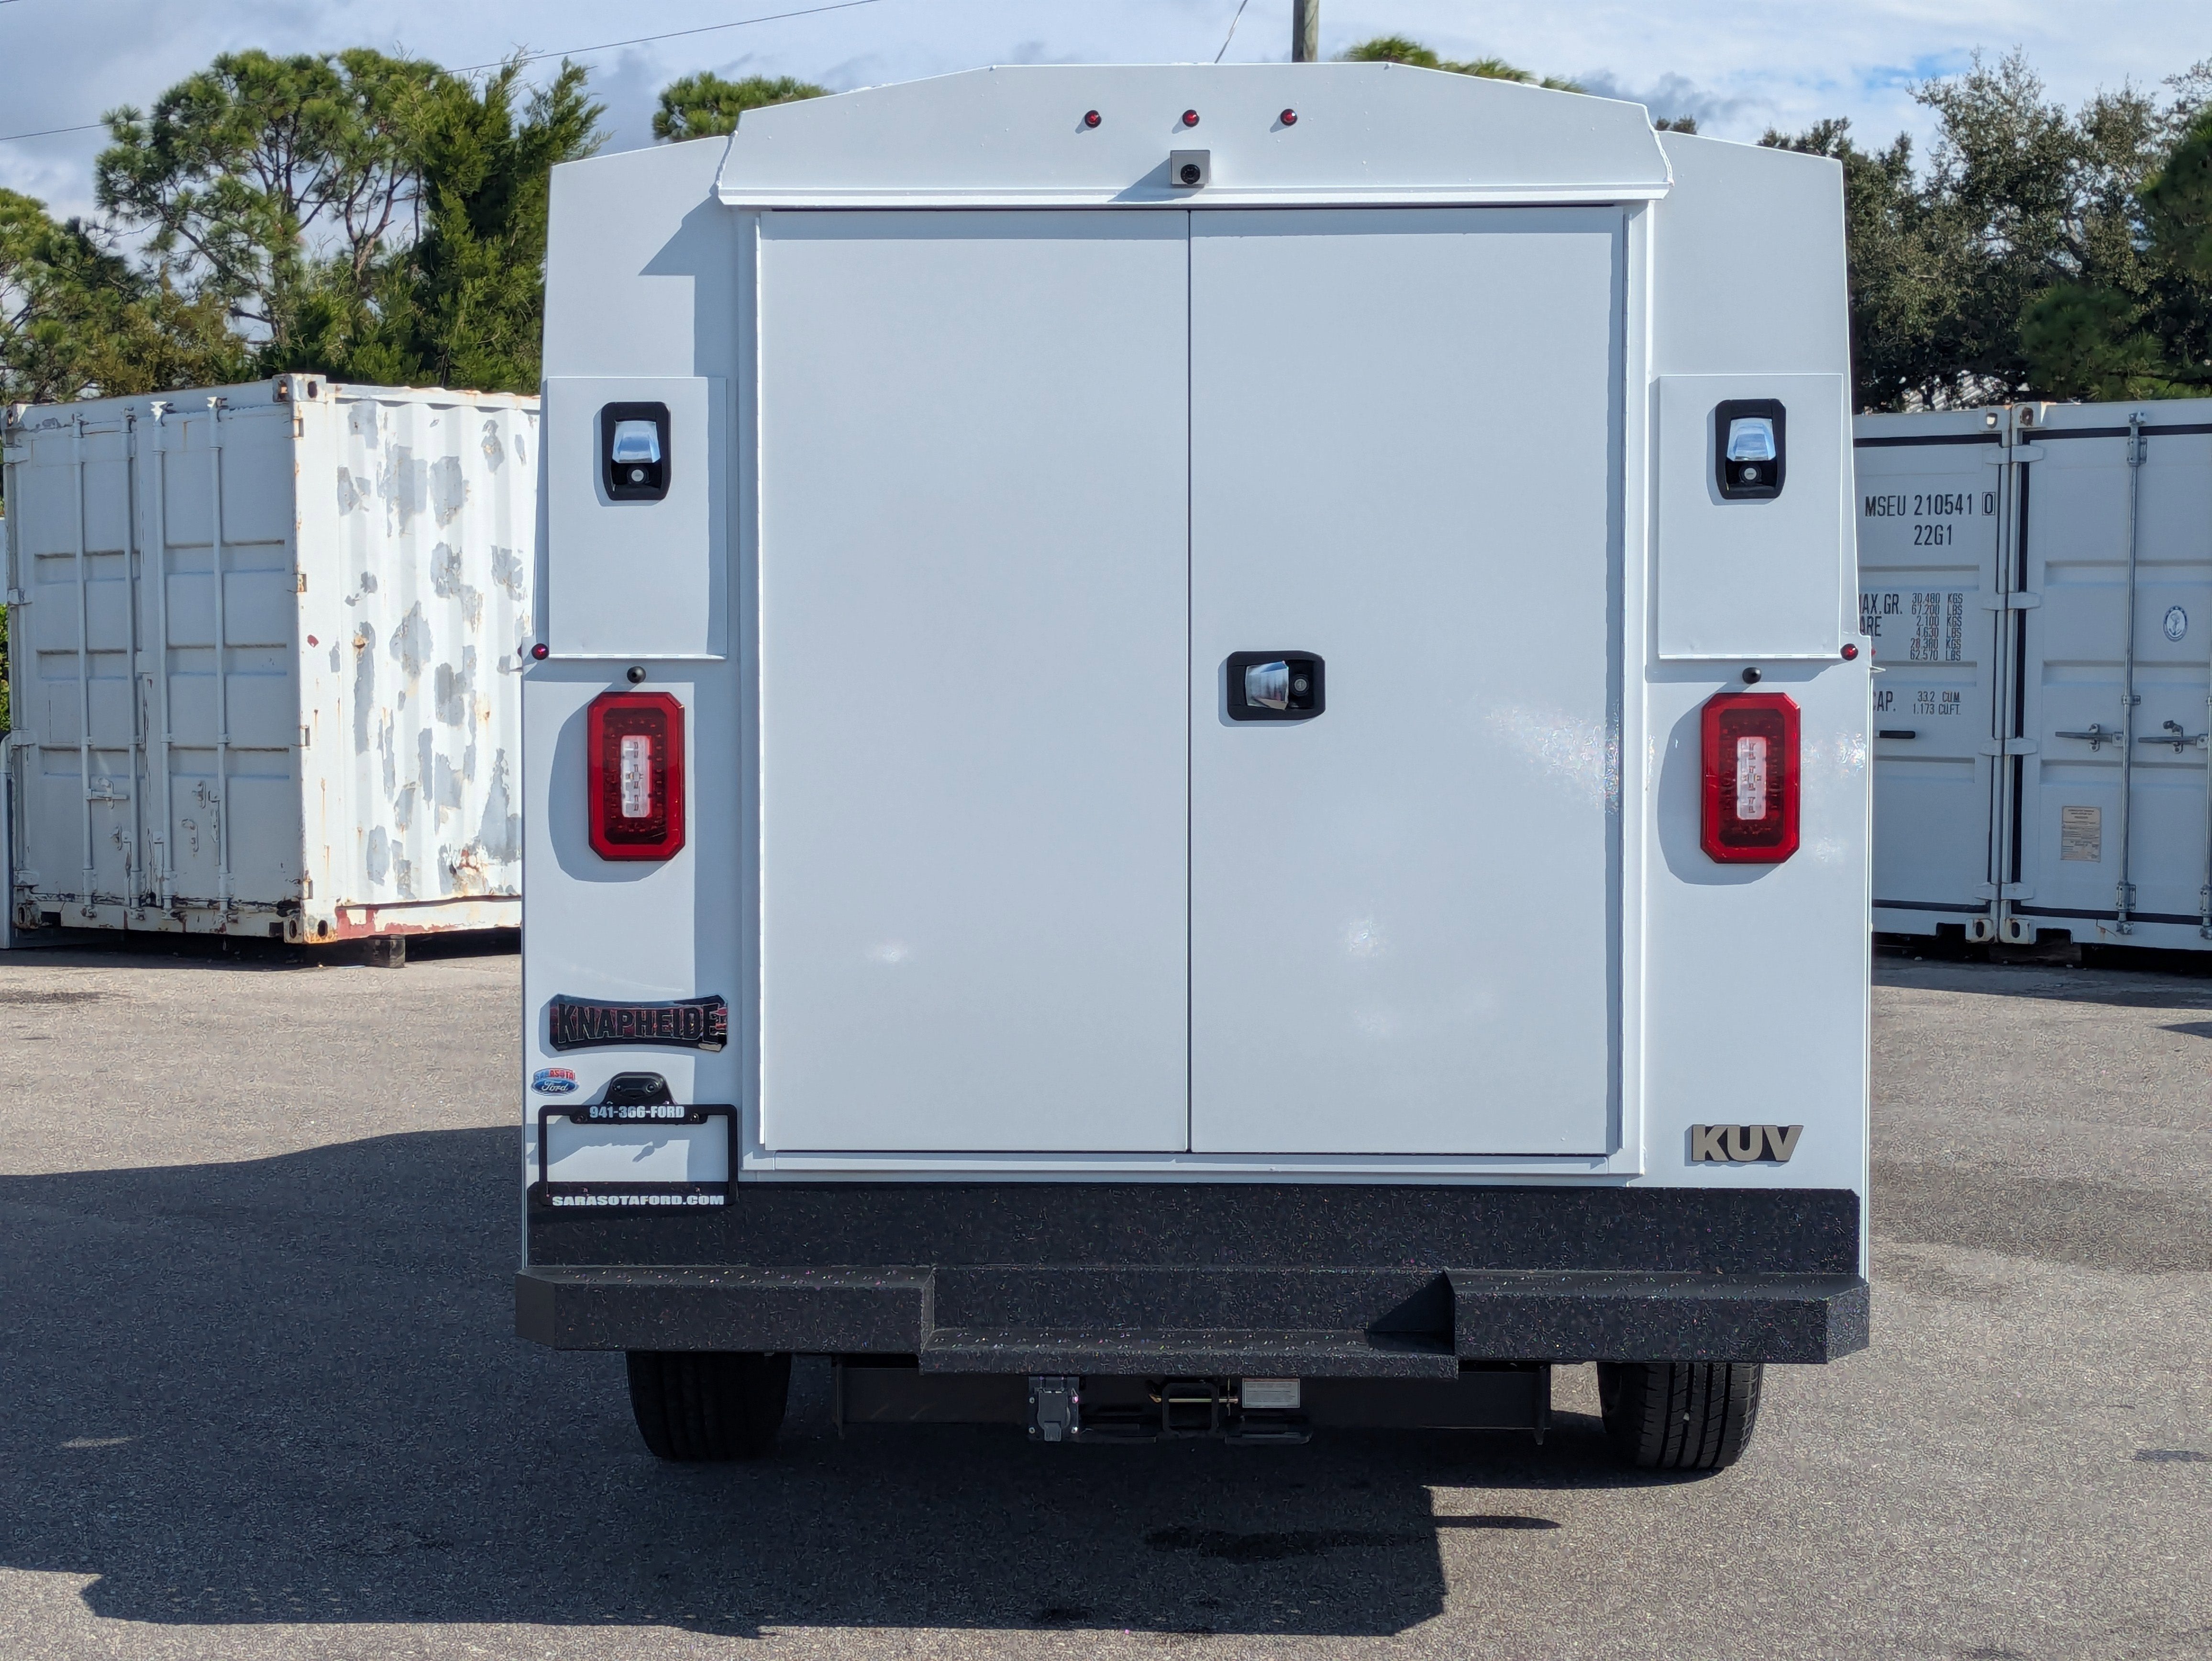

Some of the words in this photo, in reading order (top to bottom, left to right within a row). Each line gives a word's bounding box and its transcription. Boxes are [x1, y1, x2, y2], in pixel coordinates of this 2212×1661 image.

[1865, 495, 1906, 517] MSEU
[1913, 493, 1972, 516] 210541
[1914, 524, 1952, 545] 22G1
[1948, 593, 1963, 604] KGS
[1947, 604, 1962, 615] LBS
[1859, 616, 1882, 637] ARE
[1947, 615, 1962, 627] KGS
[1947, 627, 1961, 638] LBS
[1946, 638, 1961, 650] KGS
[1946, 650, 1961, 661] LBS
[557, 1003, 719, 1043] KNAPHEIDE
[541, 1080, 569, 1092] Ford
[1692, 1124, 1804, 1162] KUV
[552, 1196, 724, 1206] SARASOTAFORD.COM
